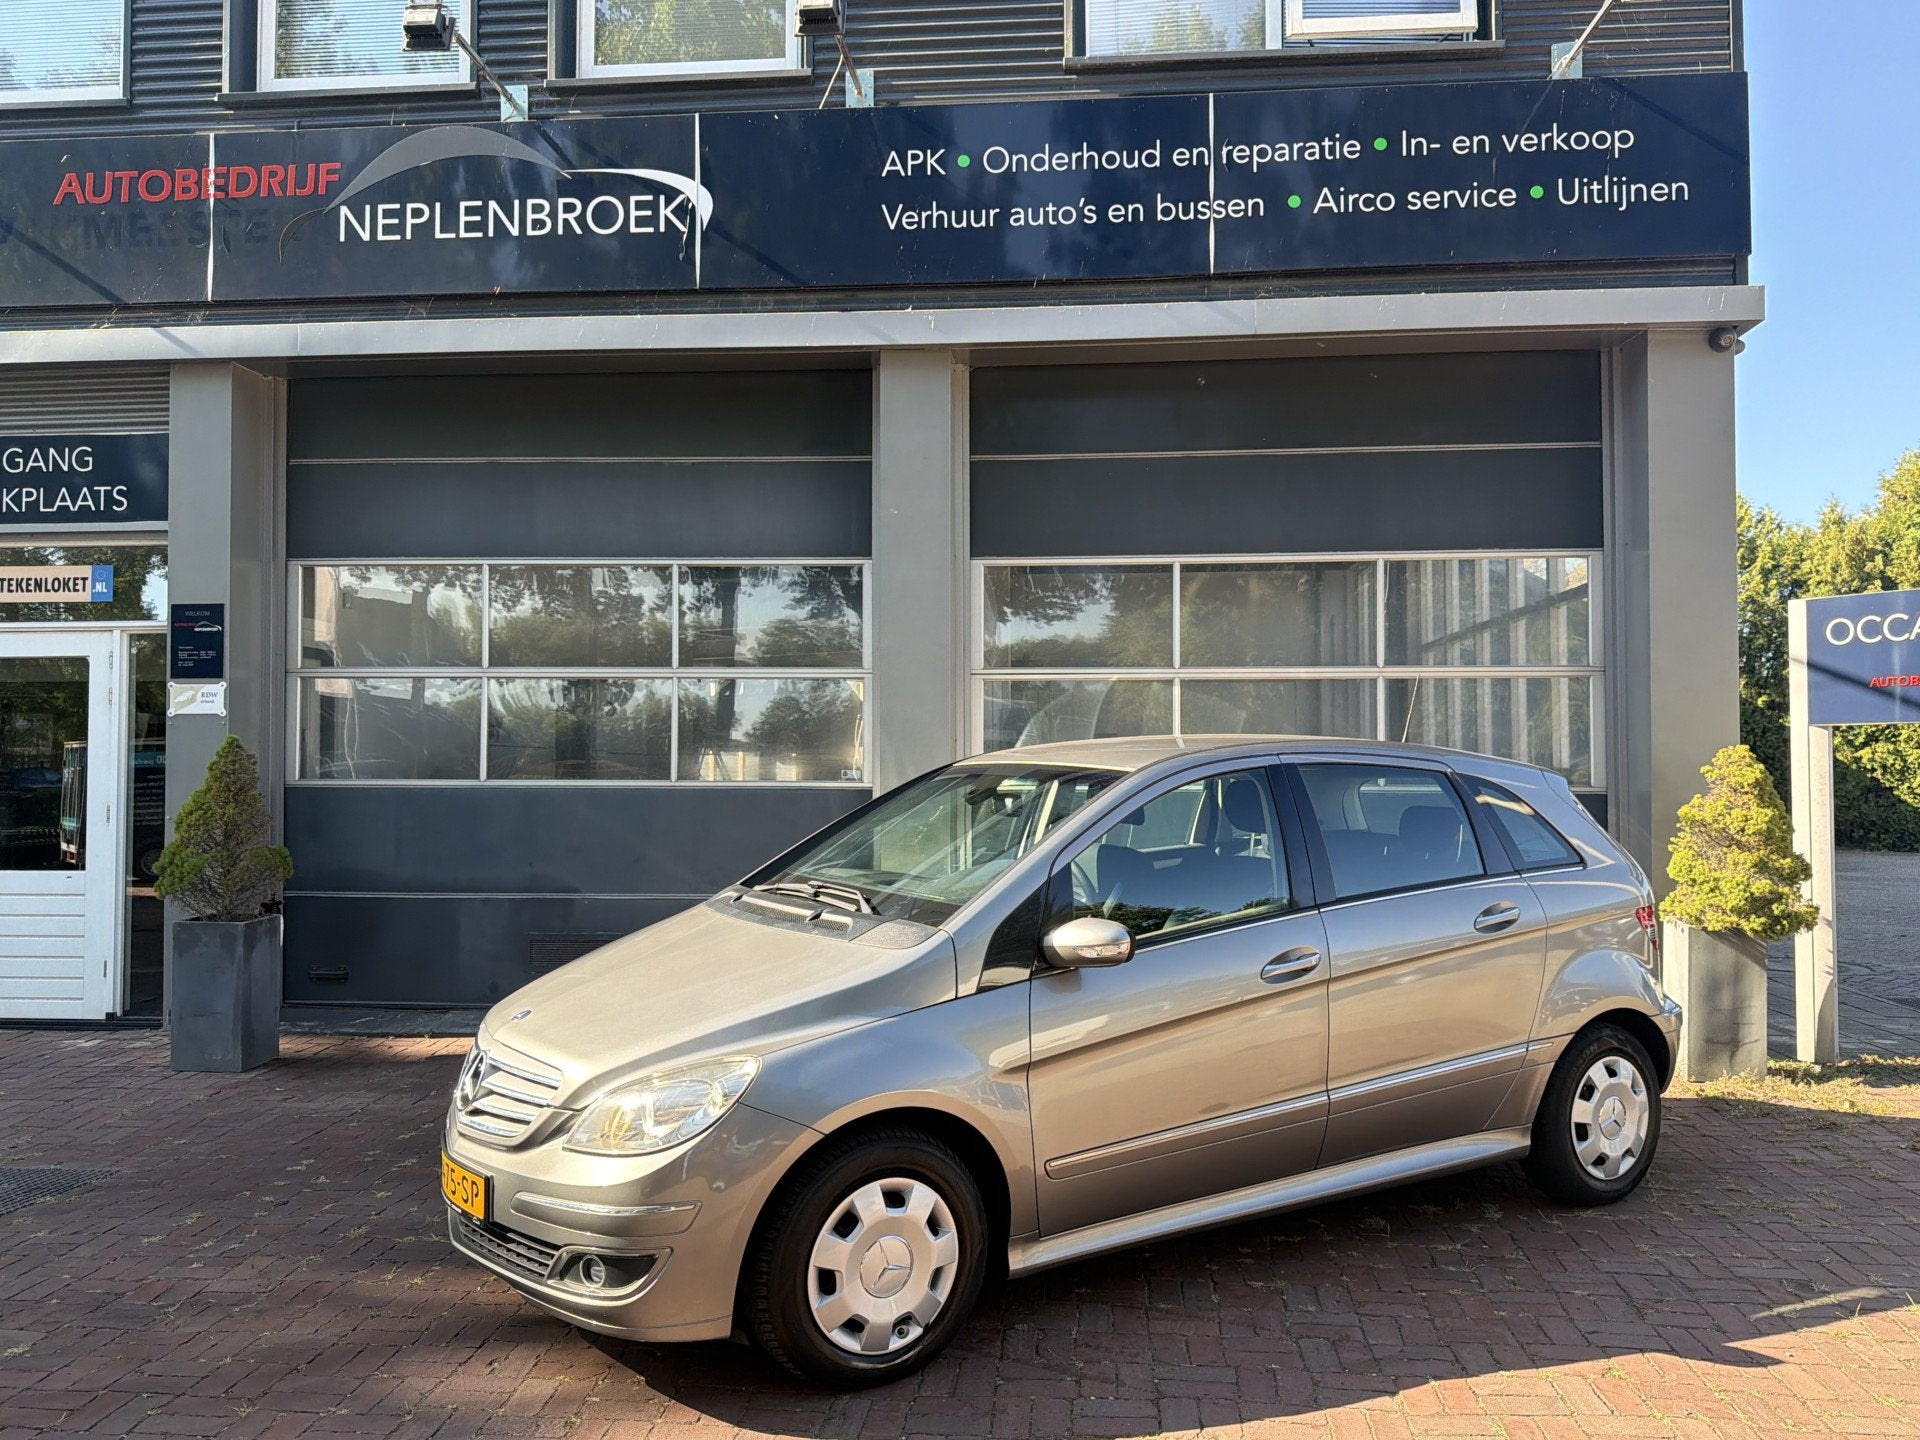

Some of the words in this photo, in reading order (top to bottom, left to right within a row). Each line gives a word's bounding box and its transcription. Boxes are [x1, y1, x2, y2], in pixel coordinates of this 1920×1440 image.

[983, 140, 1161, 174] Onderhoud
[1172, 147, 1210, 167] en
[1223, 134, 1361, 173] reparatie
[1402, 130, 1441, 157] In-
[1452, 134, 1490, 155] en
[1501, 122, 1635, 158] verkoop
[881, 149, 946, 177] APK
[53, 162, 341, 206] AUTOBEDRIJF
[1313, 187, 1396, 214] Airco
[1406, 181, 1517, 210] service
[1557, 175, 1690, 211] Uitlijnen
[338, 194, 690, 243] NEPLENBROEK
[881, 201, 1000, 231] Verhuur
[1107, 204, 1144, 223] en
[1156, 193, 1265, 221] bussen
[2, 446, 94, 473] GANG
[1, 485, 128, 513] KPLAATS
[0, 576, 89, 593] TEKENLOKET
[1869, 675, 1920, 688] AUTOB
